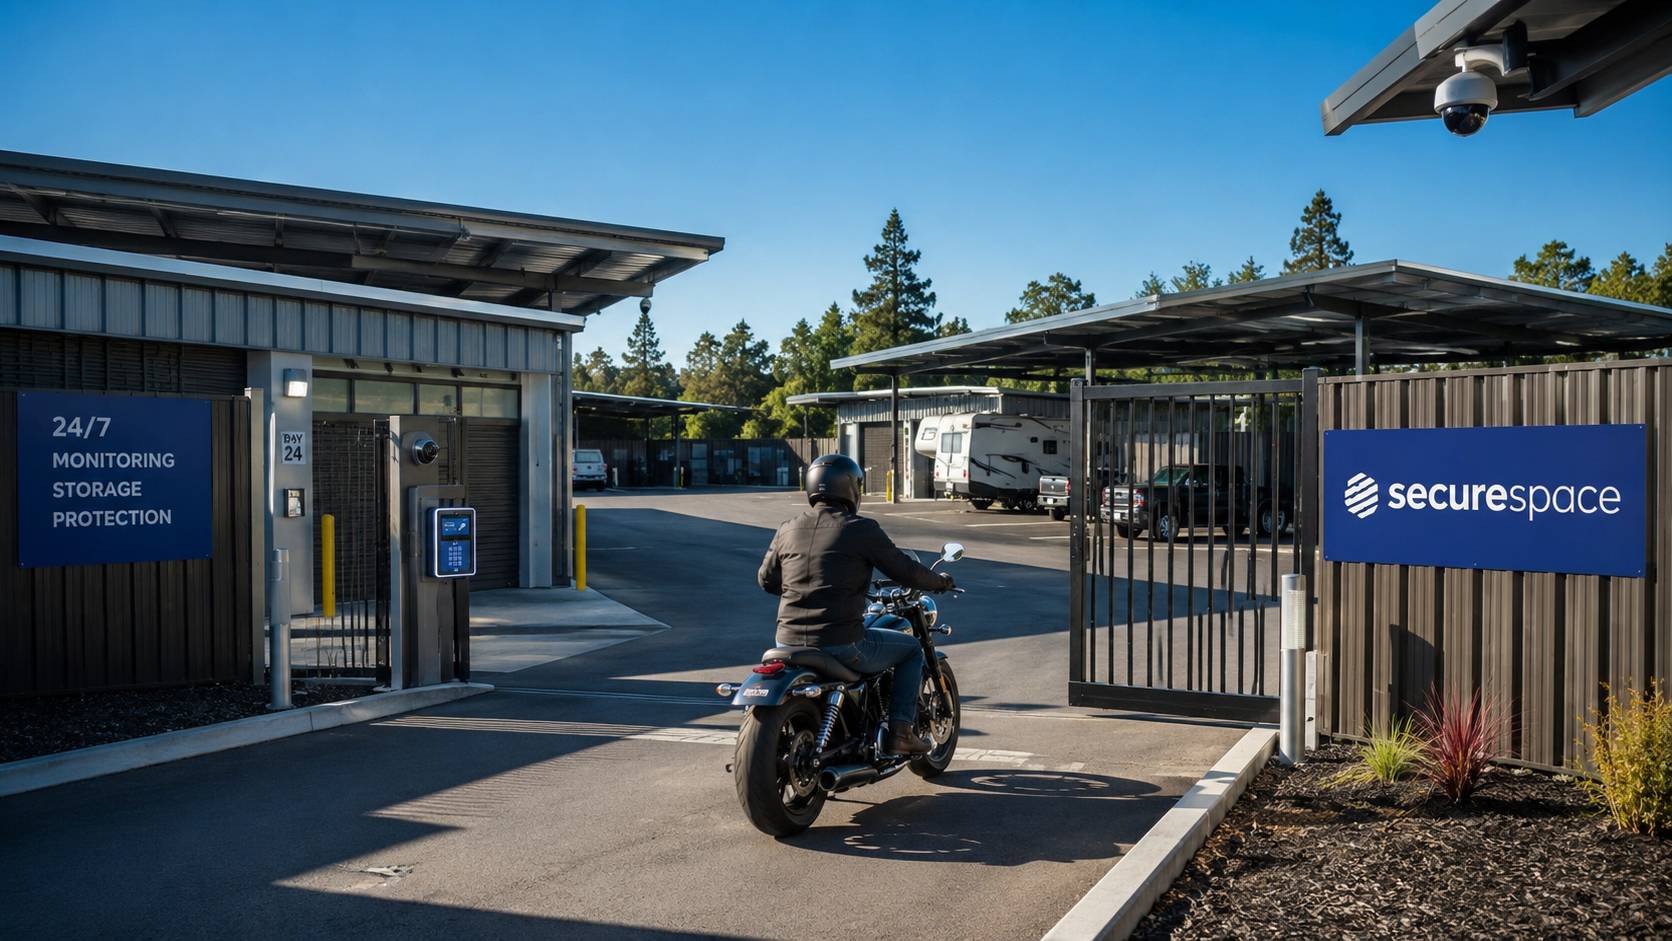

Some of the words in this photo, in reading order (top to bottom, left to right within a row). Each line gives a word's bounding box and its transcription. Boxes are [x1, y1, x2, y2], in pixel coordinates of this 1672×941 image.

[52, 415, 112, 440] 24/7
[52, 451, 176, 469] MONITORING
[284, 445, 303, 461] 24
[52, 480, 142, 499] STORAGE
[1387, 481, 1622, 522] securespace
[52, 508, 172, 529] PROTECTION
